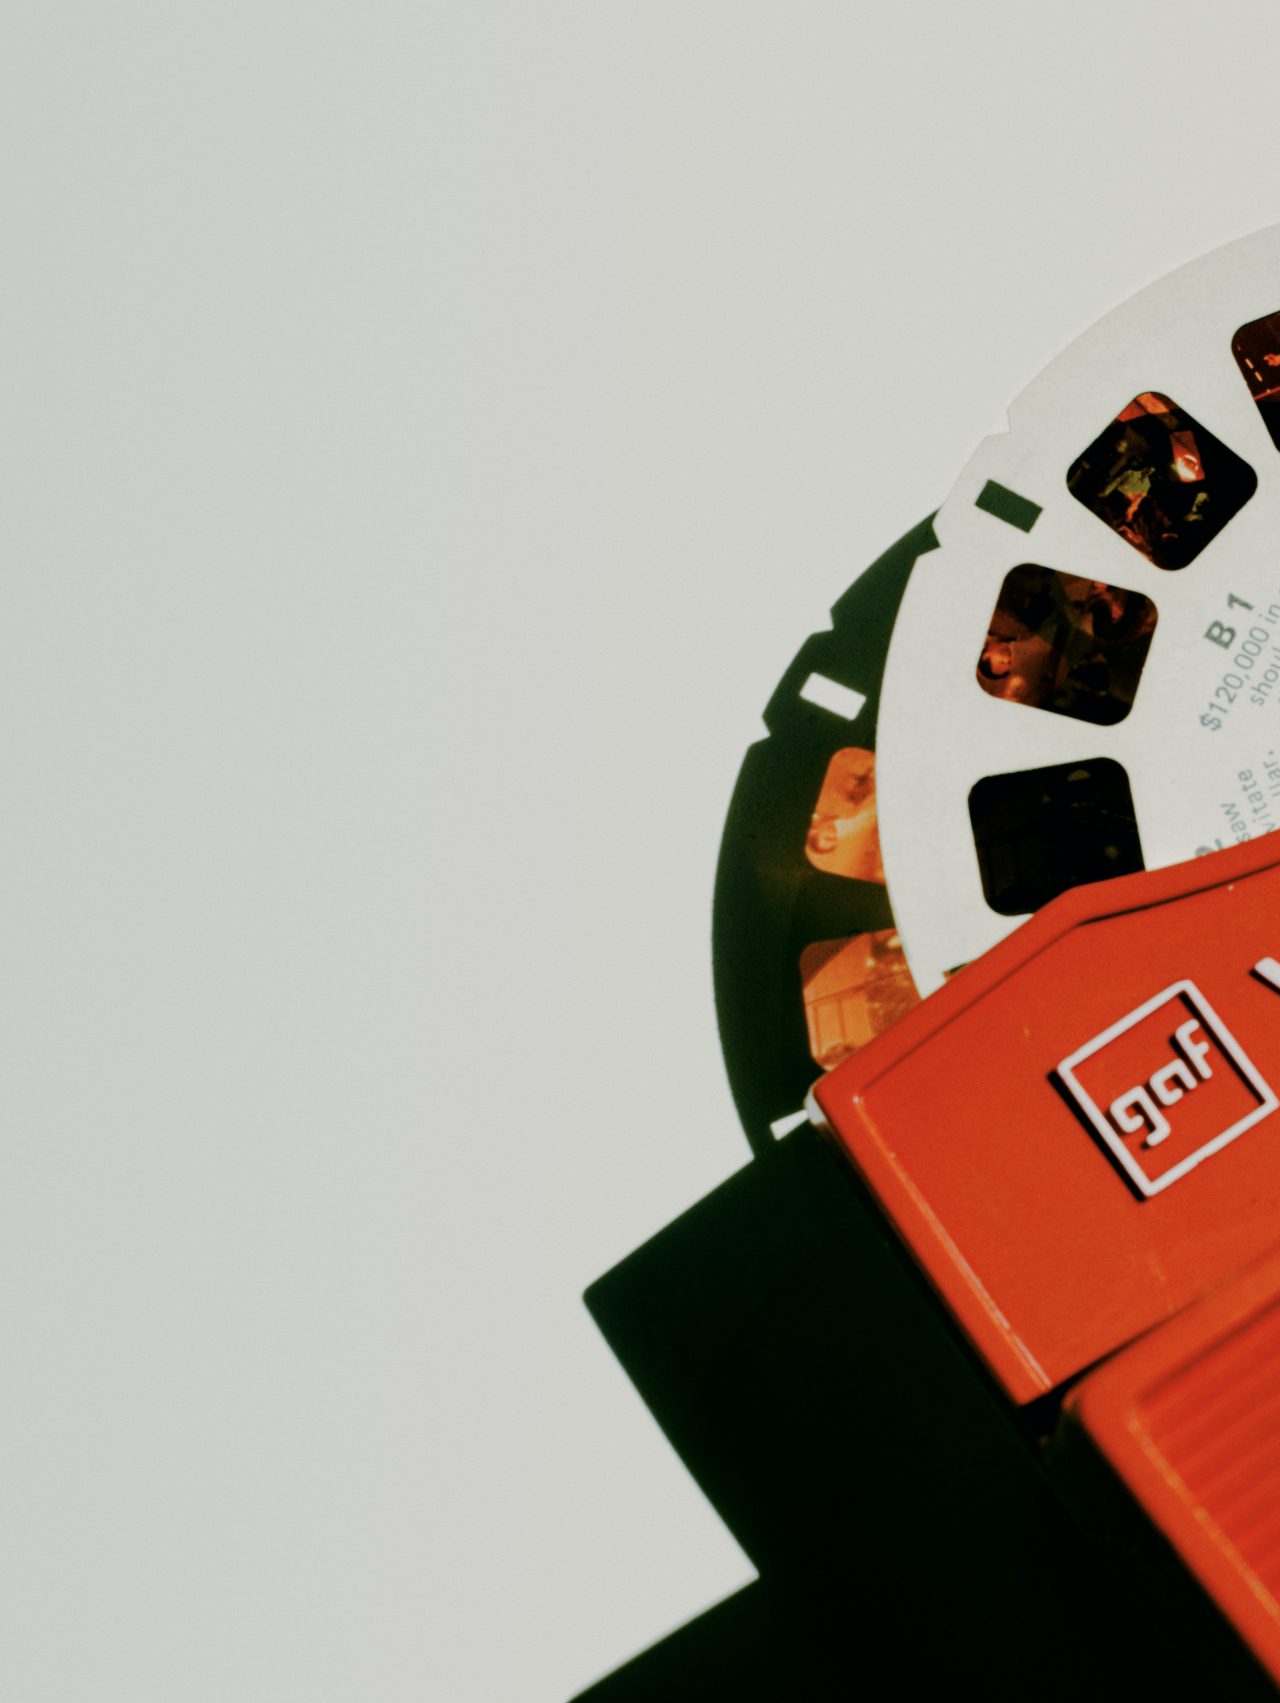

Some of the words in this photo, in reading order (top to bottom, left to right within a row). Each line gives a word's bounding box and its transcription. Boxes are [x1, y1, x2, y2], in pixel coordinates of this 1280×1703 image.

[1203, 619, 1237, 650] B
[1226, 592, 1254, 612] 1
[1198, 626, 1270, 732] $120,000
[1237, 768, 1276, 835] vitate
[1109, 1018, 1214, 1147] gaf
